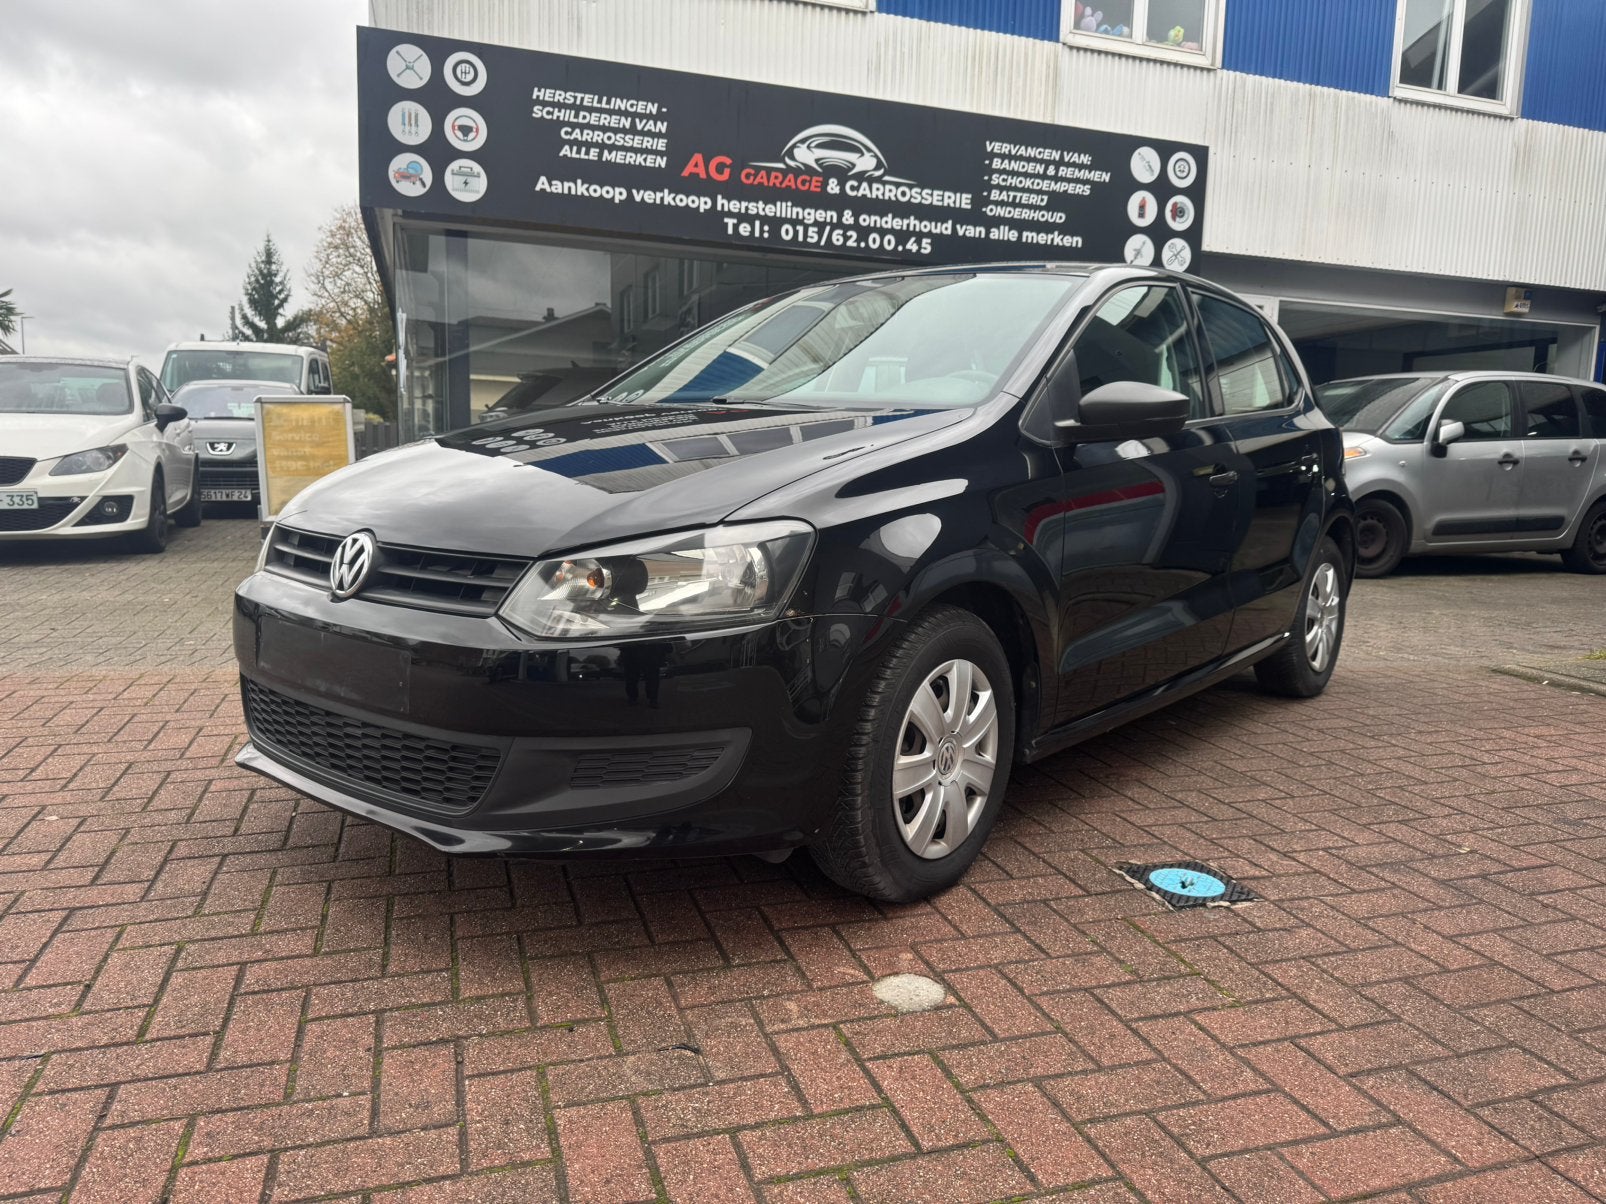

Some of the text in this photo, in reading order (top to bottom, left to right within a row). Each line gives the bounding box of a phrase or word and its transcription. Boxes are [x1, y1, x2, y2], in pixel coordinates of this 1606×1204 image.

[532, 87, 658, 115] HERSTELLINGEN
[532, 105, 667, 133] SCHILDEREN VAN
[560, 127, 667, 151] CARROSSERIE
[559, 145, 667, 168] ALLE MERKEN
[985, 140, 1092, 165] VERVANGEN VAN:
[681, 153, 972, 209] AG GARAGE & CARROSSERIE
[991, 158, 1045, 175] BANDEN
[1046, 165, 1056, 176] &
[1058, 166, 1111, 183] REMMEN
[990, 174, 1091, 196] SCHOKDEMPERS
[990, 189, 1048, 206] BATTERIJ
[535, 175, 1083, 248] Aankoop verkoop herstellingen & onderhoud van alle merken
[723, 217, 932, 254] Tel: 015/62.00.45
